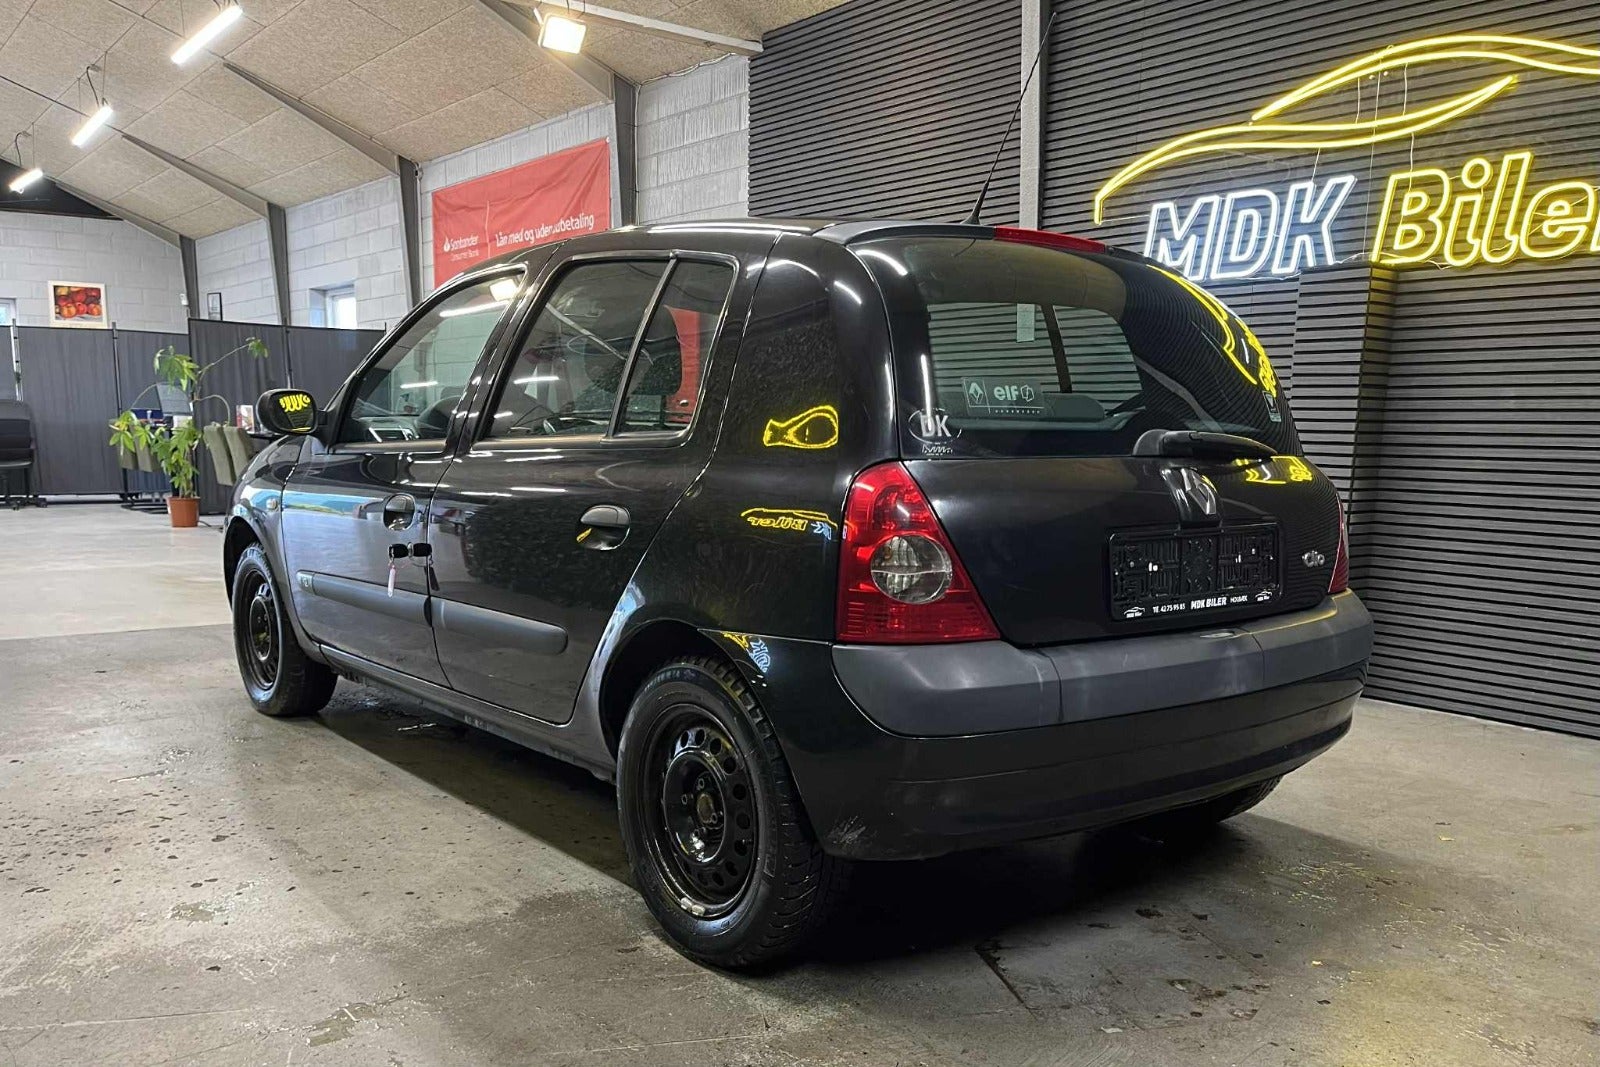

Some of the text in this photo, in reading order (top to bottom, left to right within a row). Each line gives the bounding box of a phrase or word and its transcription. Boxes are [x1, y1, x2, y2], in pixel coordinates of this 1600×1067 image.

[1144, 151, 1600, 281] MDK Bile
[495, 231, 508, 248] Lån
[508, 228, 524, 244] med
[524, 228, 535, 244] og
[993, 385, 1018, 401] elf
[920, 414, 952, 437] DK
[1190, 599, 1205, 610] MDK
[1206, 596, 1227, 607] BILER
